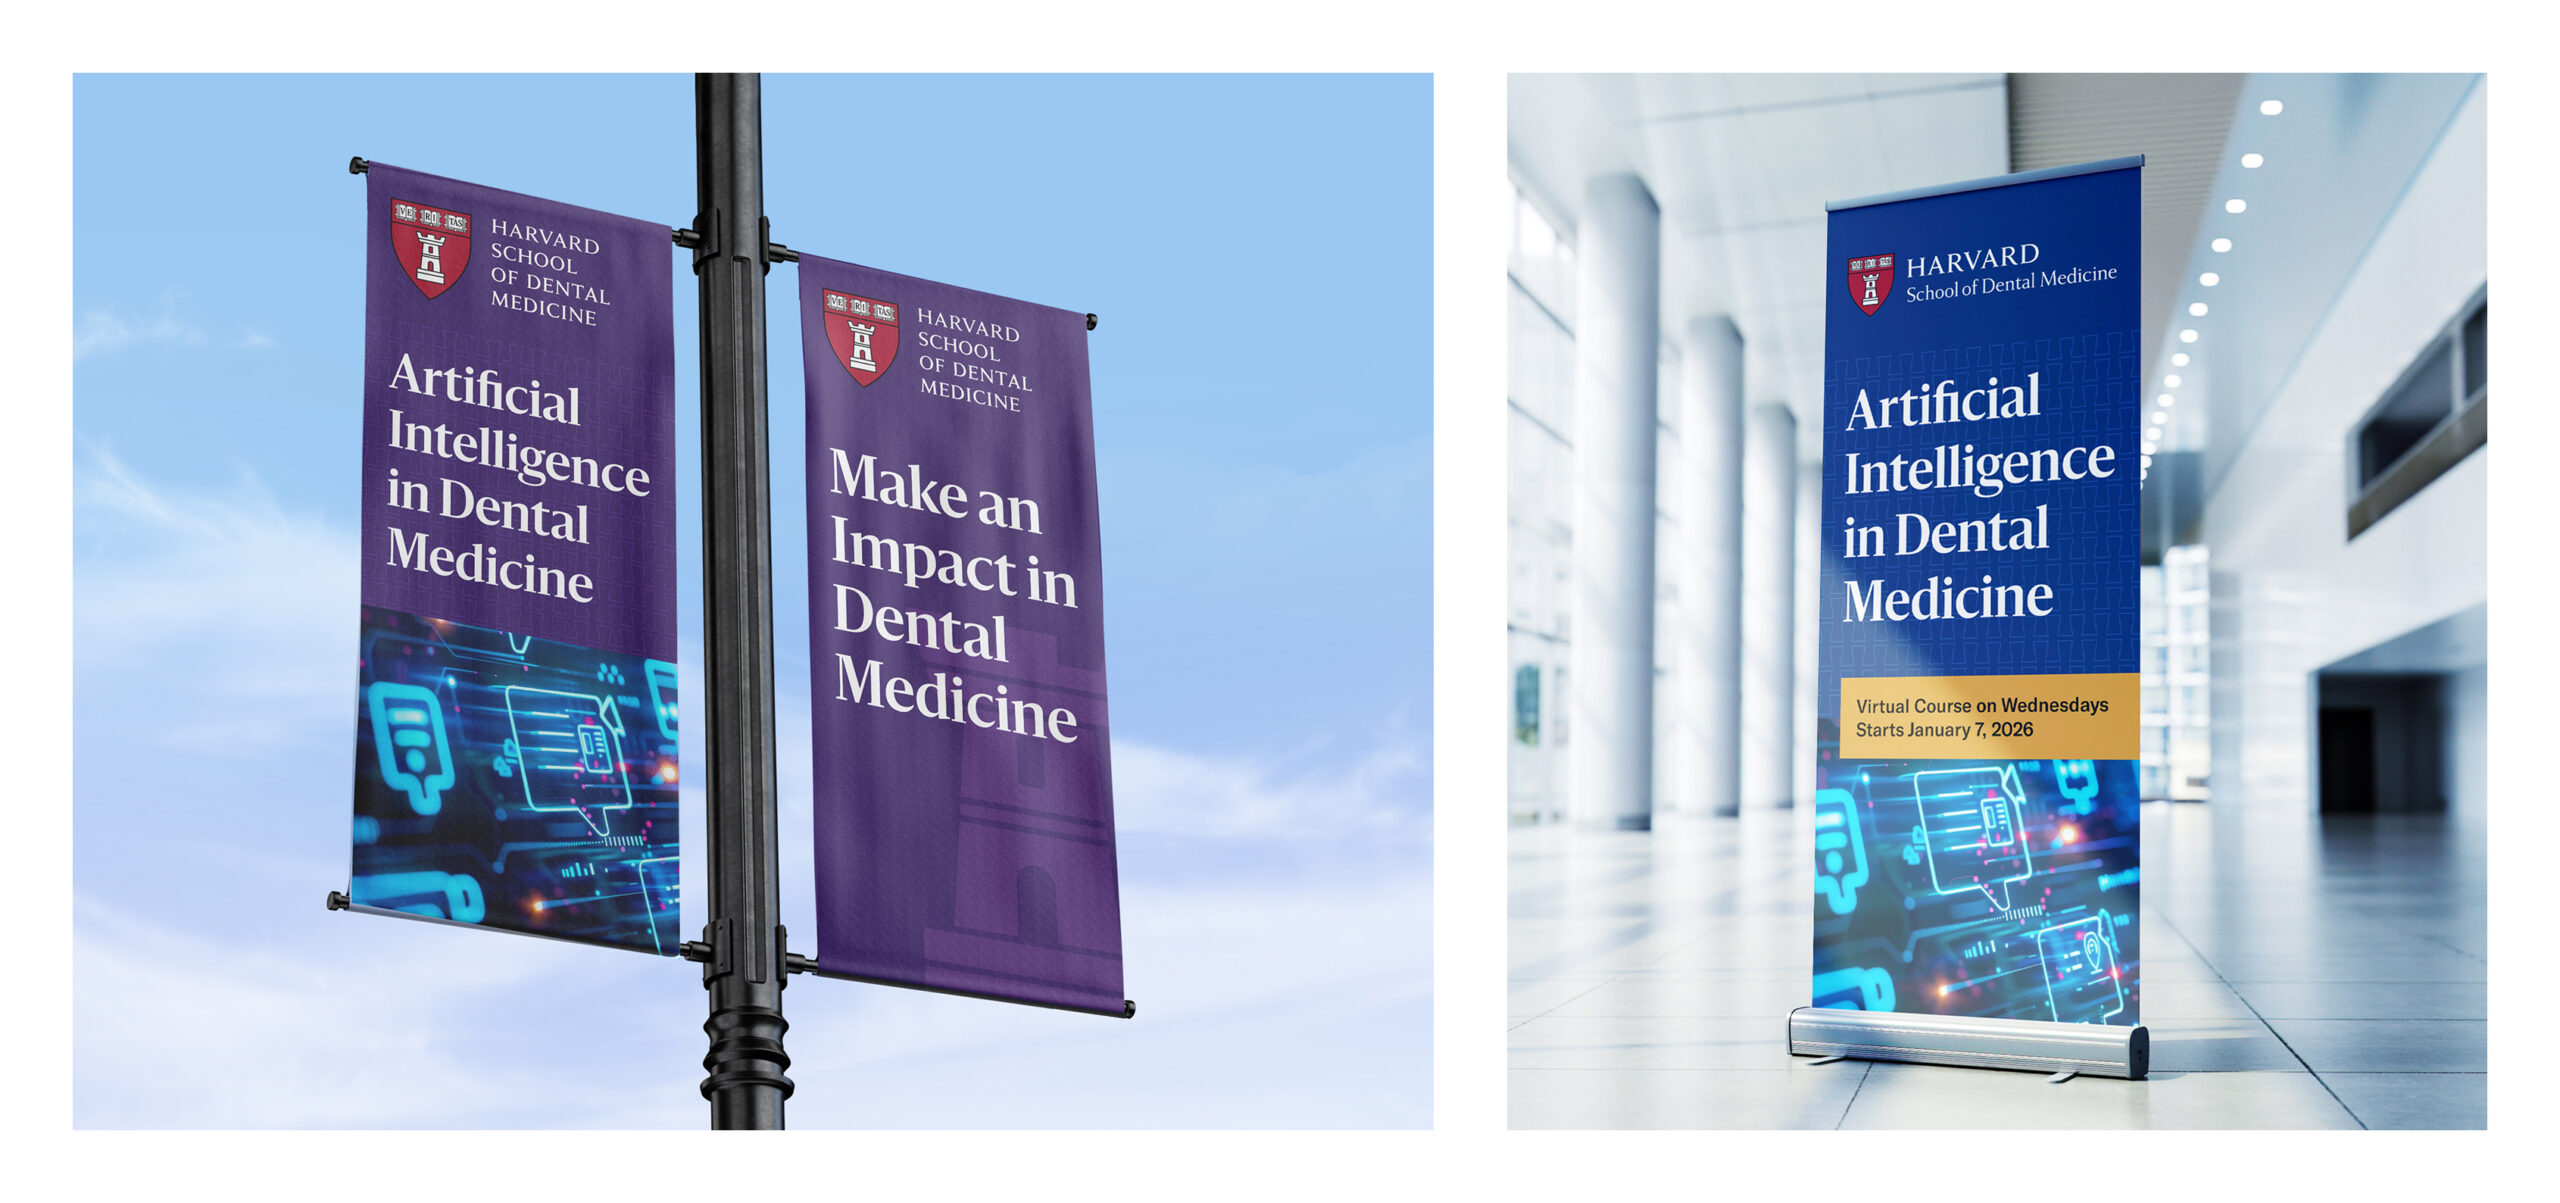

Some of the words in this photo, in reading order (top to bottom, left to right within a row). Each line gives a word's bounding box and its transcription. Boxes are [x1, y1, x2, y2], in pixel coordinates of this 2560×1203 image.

[492, 218, 600, 255] HARVARD
[492, 243, 578, 274] SCHOOL
[1907, 243, 2040, 278] HARVARD
[491, 267, 519, 285] OF
[527, 274, 611, 306] DENTAL
[1906, 282, 1959, 303] School
[1961, 279, 1979, 296] of
[1982, 272, 2037, 294] Dental
[2040, 266, 2118, 287] Medicine
[491, 291, 597, 327] MEDICINE
[918, 308, 1020, 343] HARVARD
[919, 332, 1001, 363] SCHOOL
[388, 353, 581, 427] Artificial
[919, 356, 945, 373] OF
[953, 362, 1033, 392] DENTAL
[921, 378, 1021, 413] MEDICINE
[1845, 372, 2041, 432] Artificial
[388, 409, 650, 497] Intelligence
[1845, 444, 2115, 498] Intelligence
[387, 468, 430, 514] in
[439, 478, 590, 545] Dental
[829, 448, 968, 519] Make
[978, 491, 1043, 535] an
[1843, 517, 1886, 559] in
[1895, 505, 2050, 556] Dental
[386, 527, 593, 604] Medicine
[830, 515, 1018, 597] Impact
[1027, 556, 1079, 609] in
[1842, 575, 2053, 623] Medicine
[833, 584, 1010, 663] Dental
[835, 653, 1078, 744] Medicine
[1856, 698, 1909, 714] Virtual
[1914, 698, 1972, 714] Course
[1976, 701, 1997, 713] on
[2001, 696, 2109, 716] Wednesdays
[1856, 722, 1904, 737] Starts
[1907, 722, 1971, 741] January
[1974, 721, 1987, 741] 7,
[1991, 721, 2034, 737] 2026
